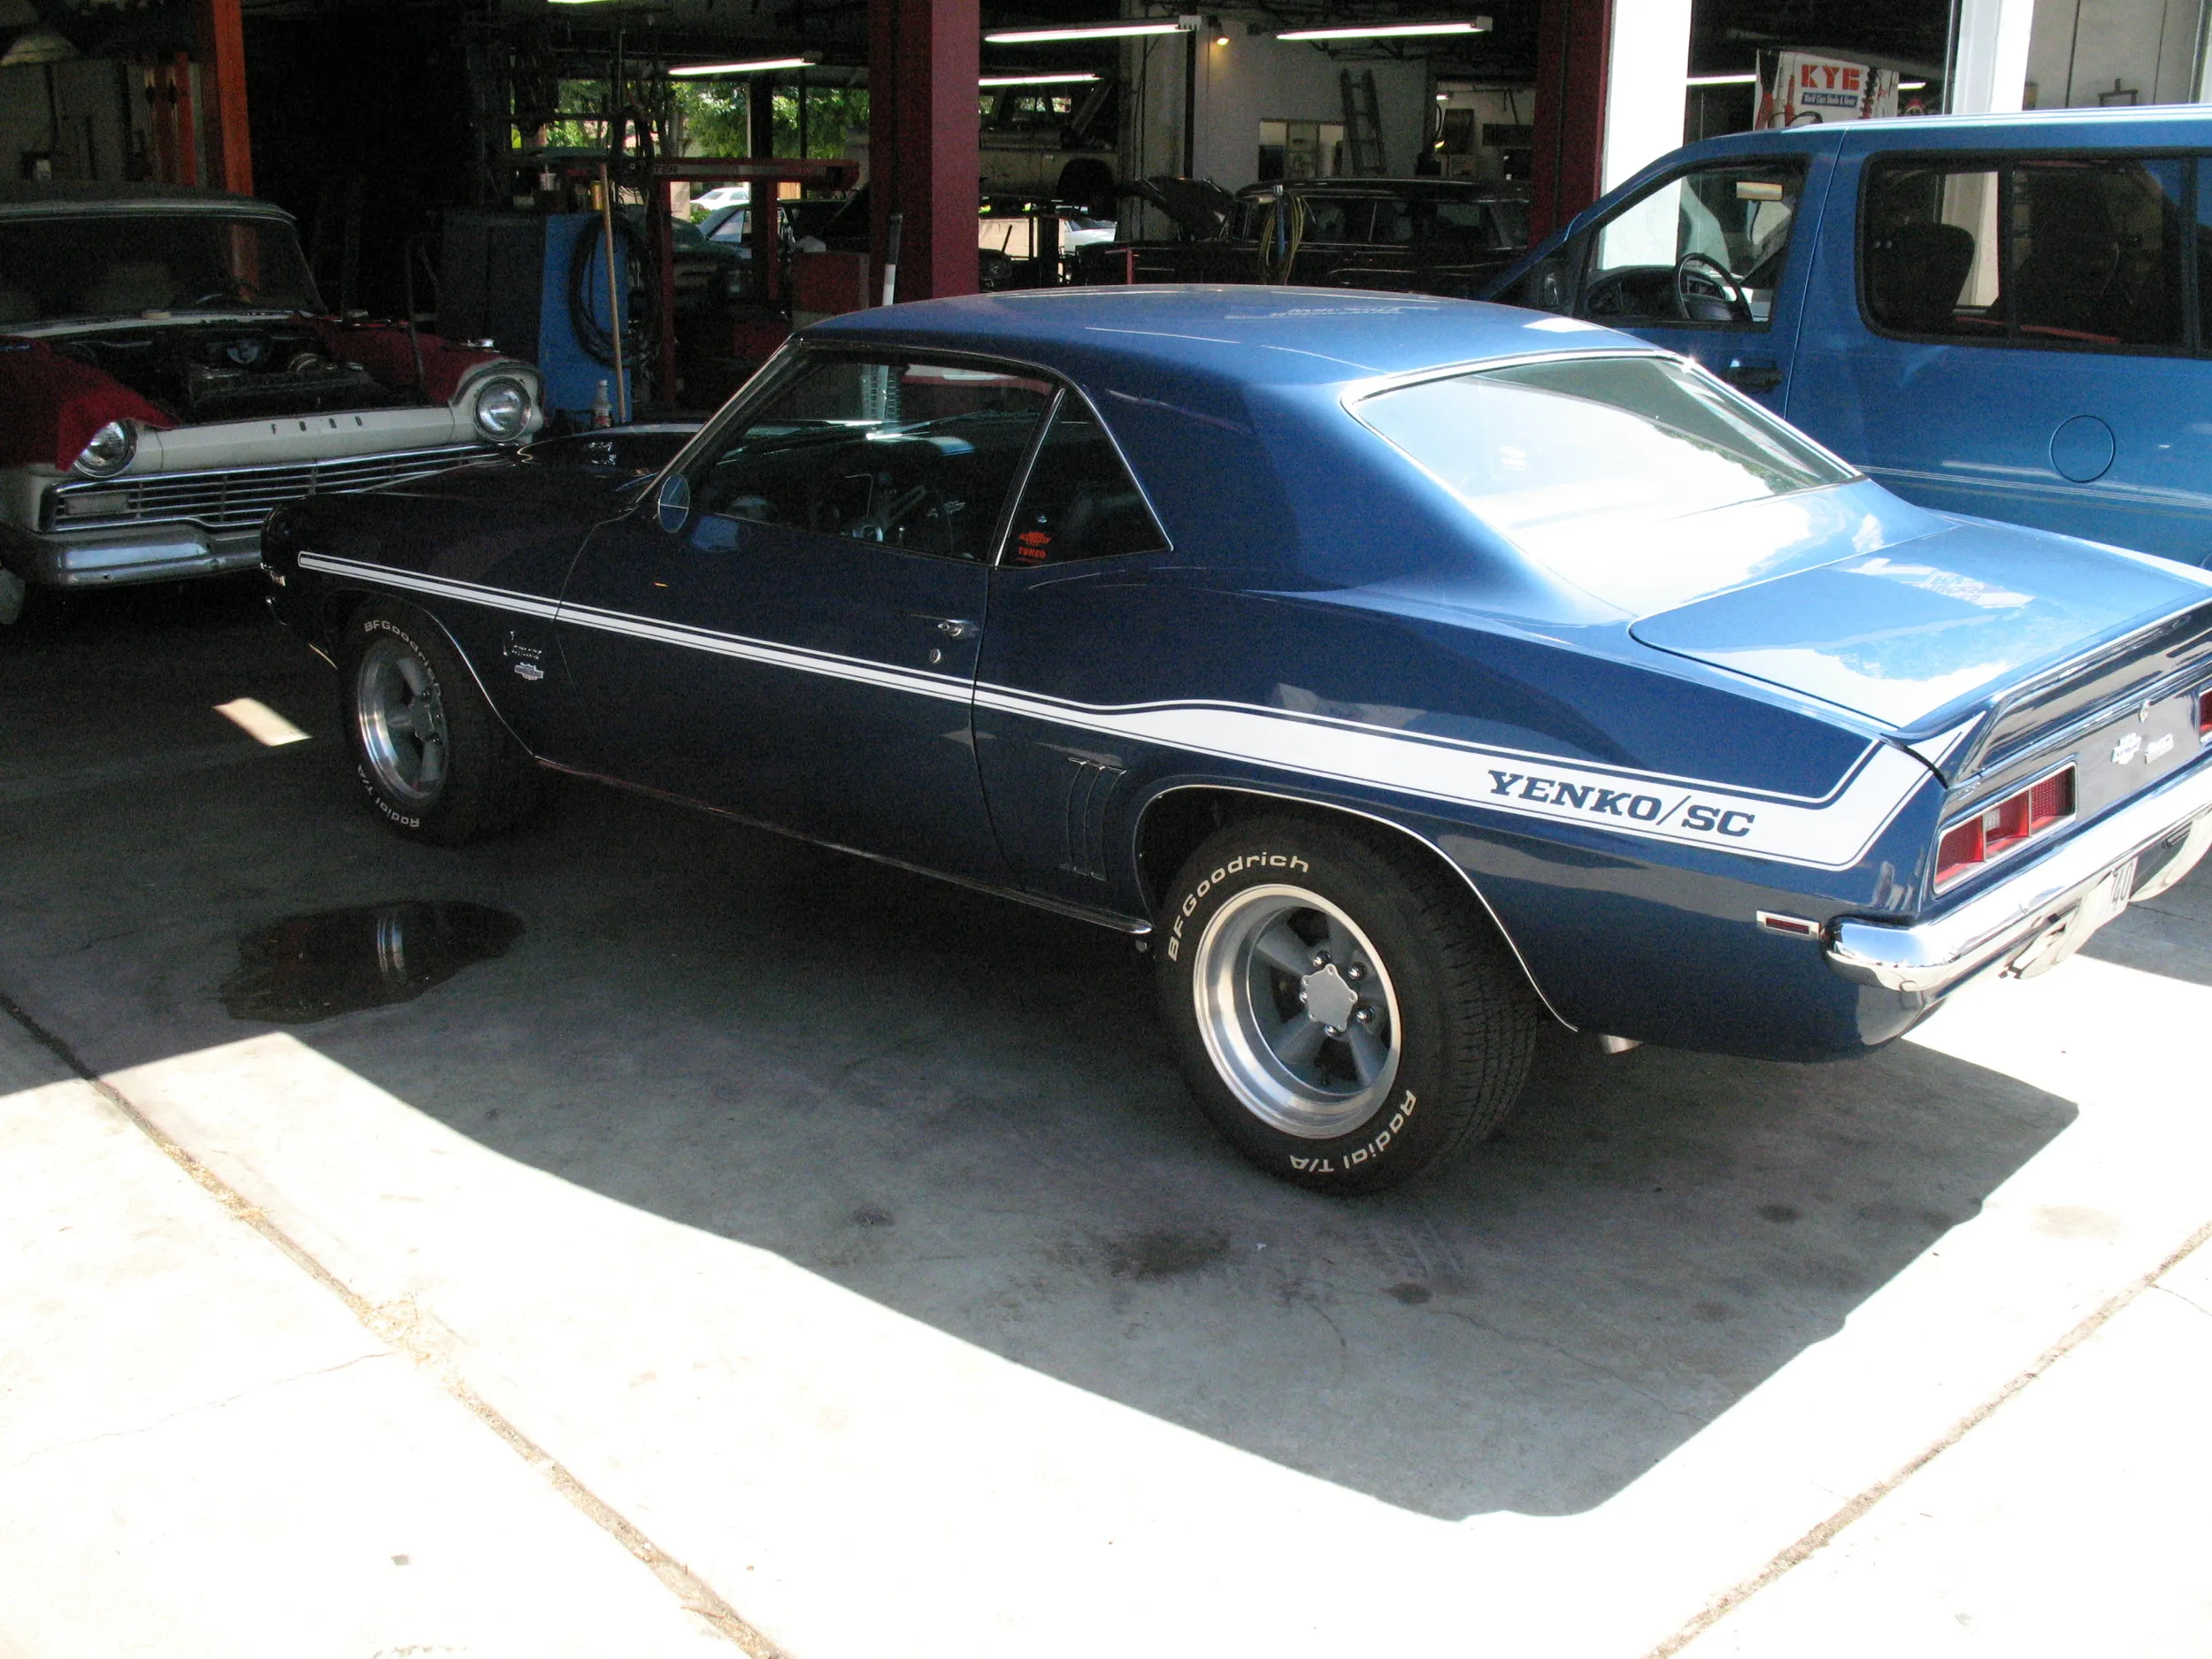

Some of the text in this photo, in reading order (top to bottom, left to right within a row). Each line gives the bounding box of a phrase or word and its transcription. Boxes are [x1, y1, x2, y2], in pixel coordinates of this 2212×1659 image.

[271, 416, 363, 434] FORD
[1487, 769, 1755, 838] YENKO/SC
[1166, 851, 1310, 962] BFGoodrich
[1288, 1089, 1417, 1172] Radial T/A
